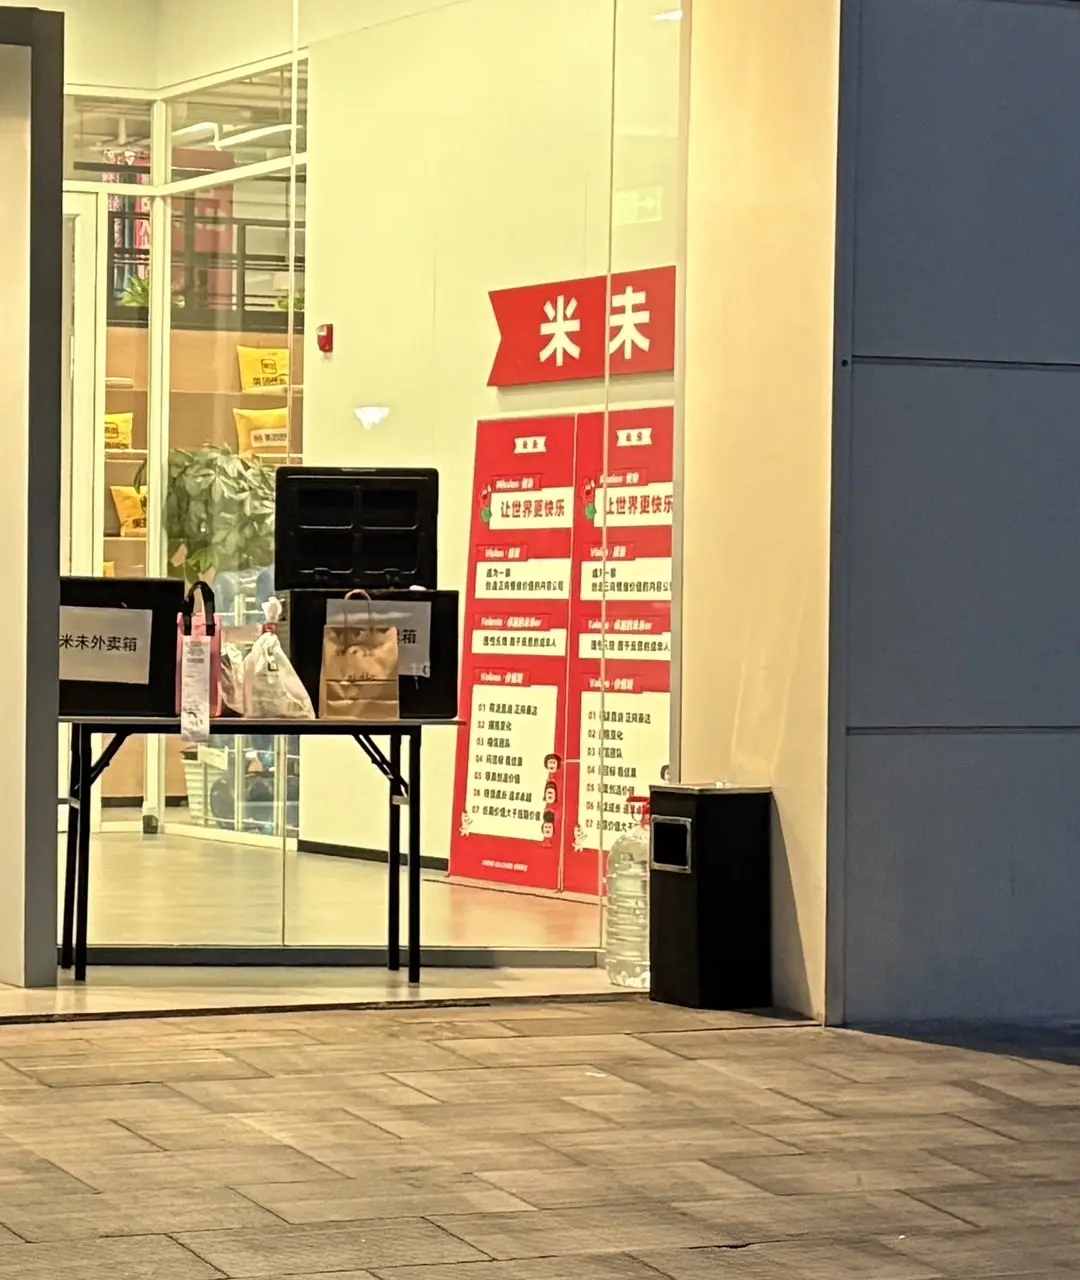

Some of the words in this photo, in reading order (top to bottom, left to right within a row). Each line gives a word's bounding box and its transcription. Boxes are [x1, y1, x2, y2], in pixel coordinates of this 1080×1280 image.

[539, 286, 651, 366] 米未
[501, 499, 565, 518] 让世界更快乐
[60, 633, 138, 653] 米未外卖箱
